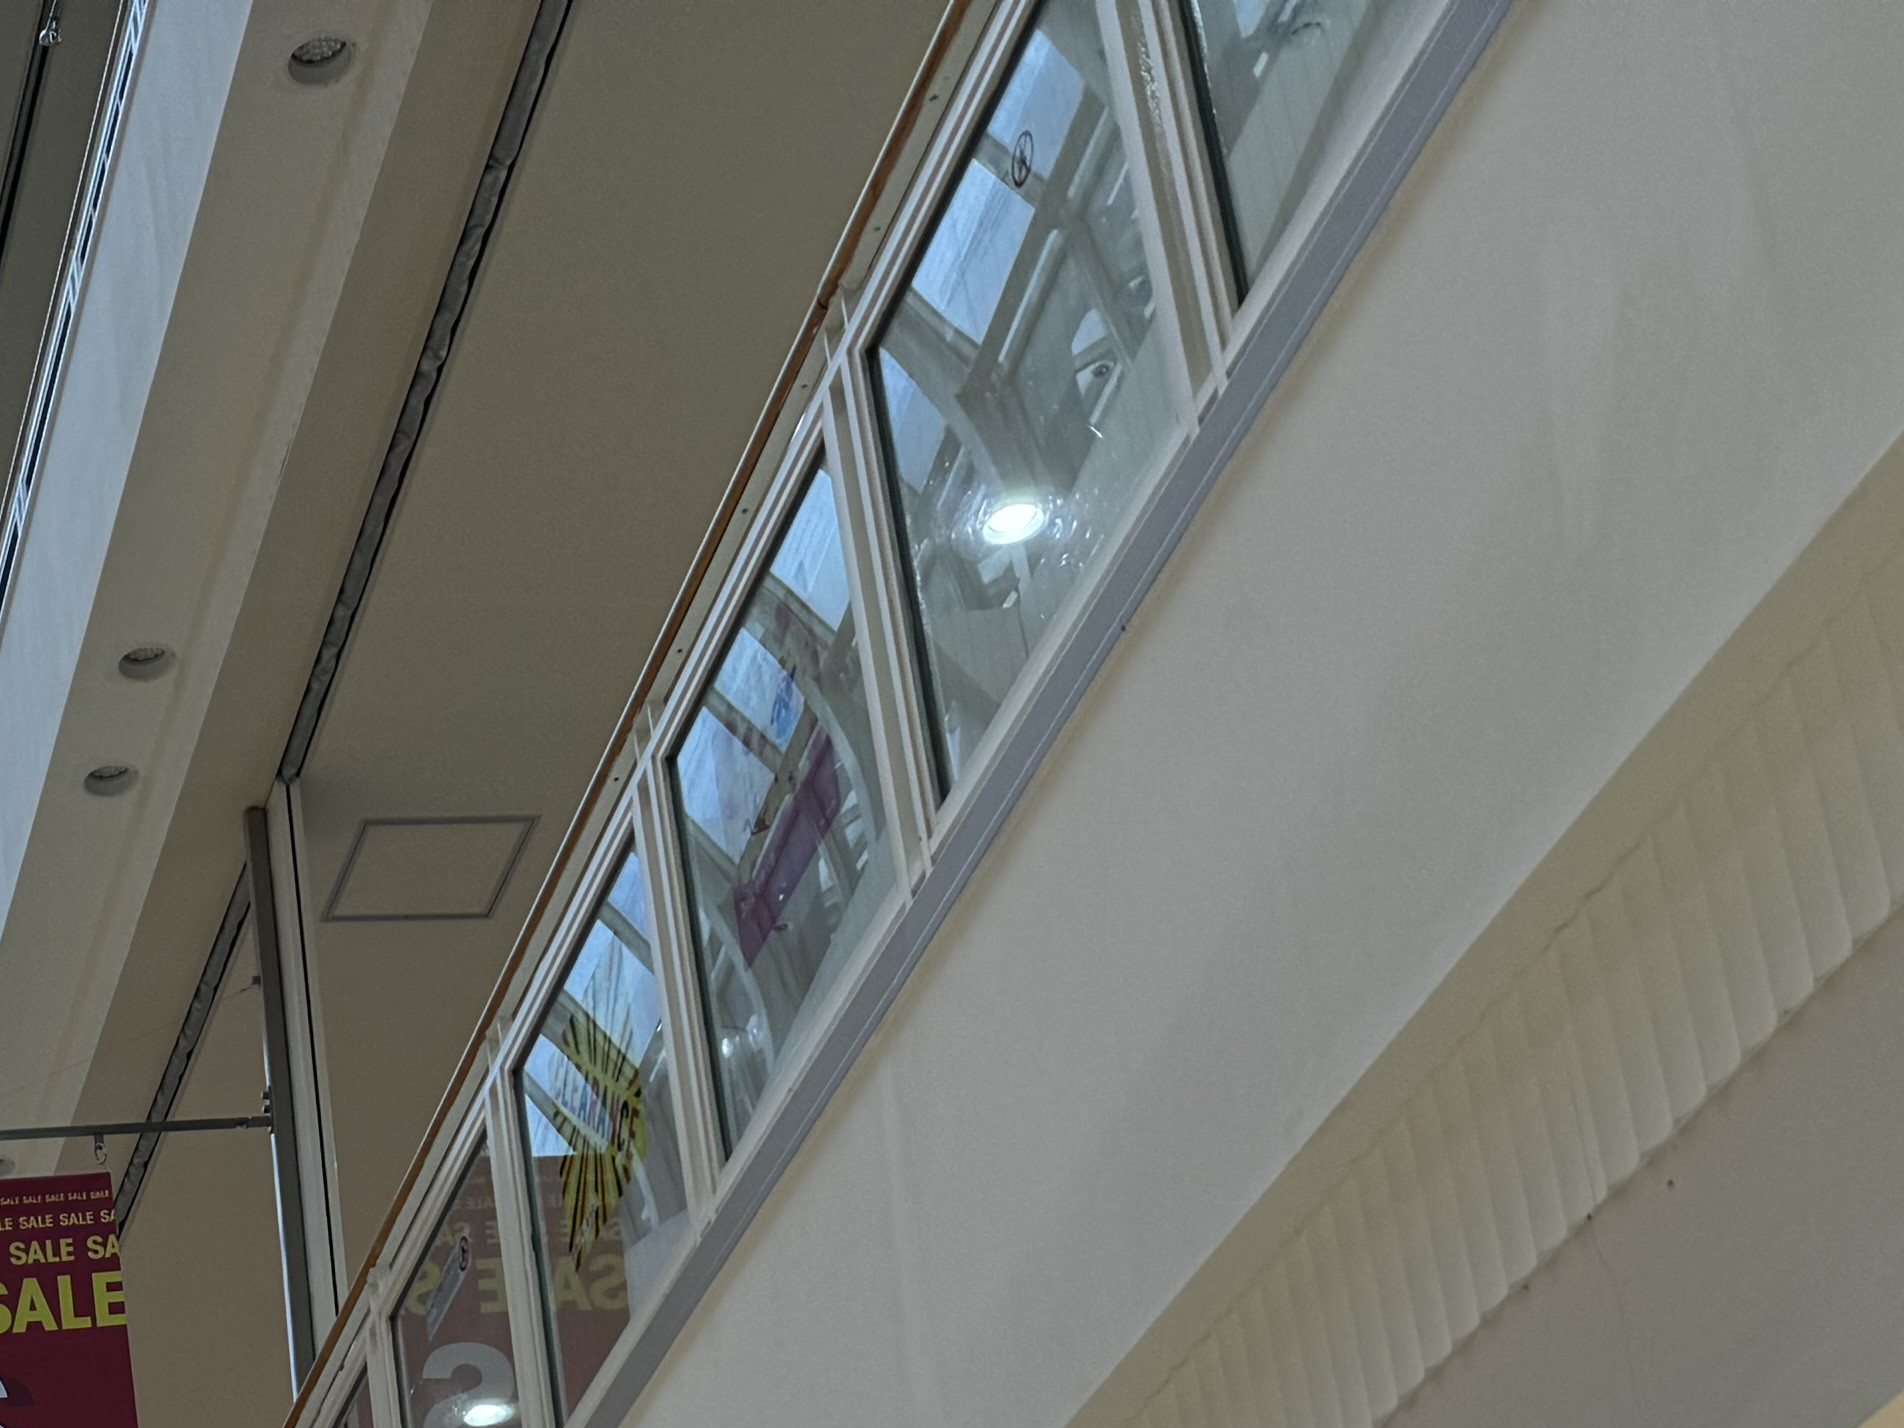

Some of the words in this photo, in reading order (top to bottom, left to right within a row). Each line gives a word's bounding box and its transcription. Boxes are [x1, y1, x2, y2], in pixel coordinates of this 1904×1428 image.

[18, 1214, 54, 1229] SALE
[59, 1211, 95, 1227] SALE
[9, 1237, 75, 1266] SALE
